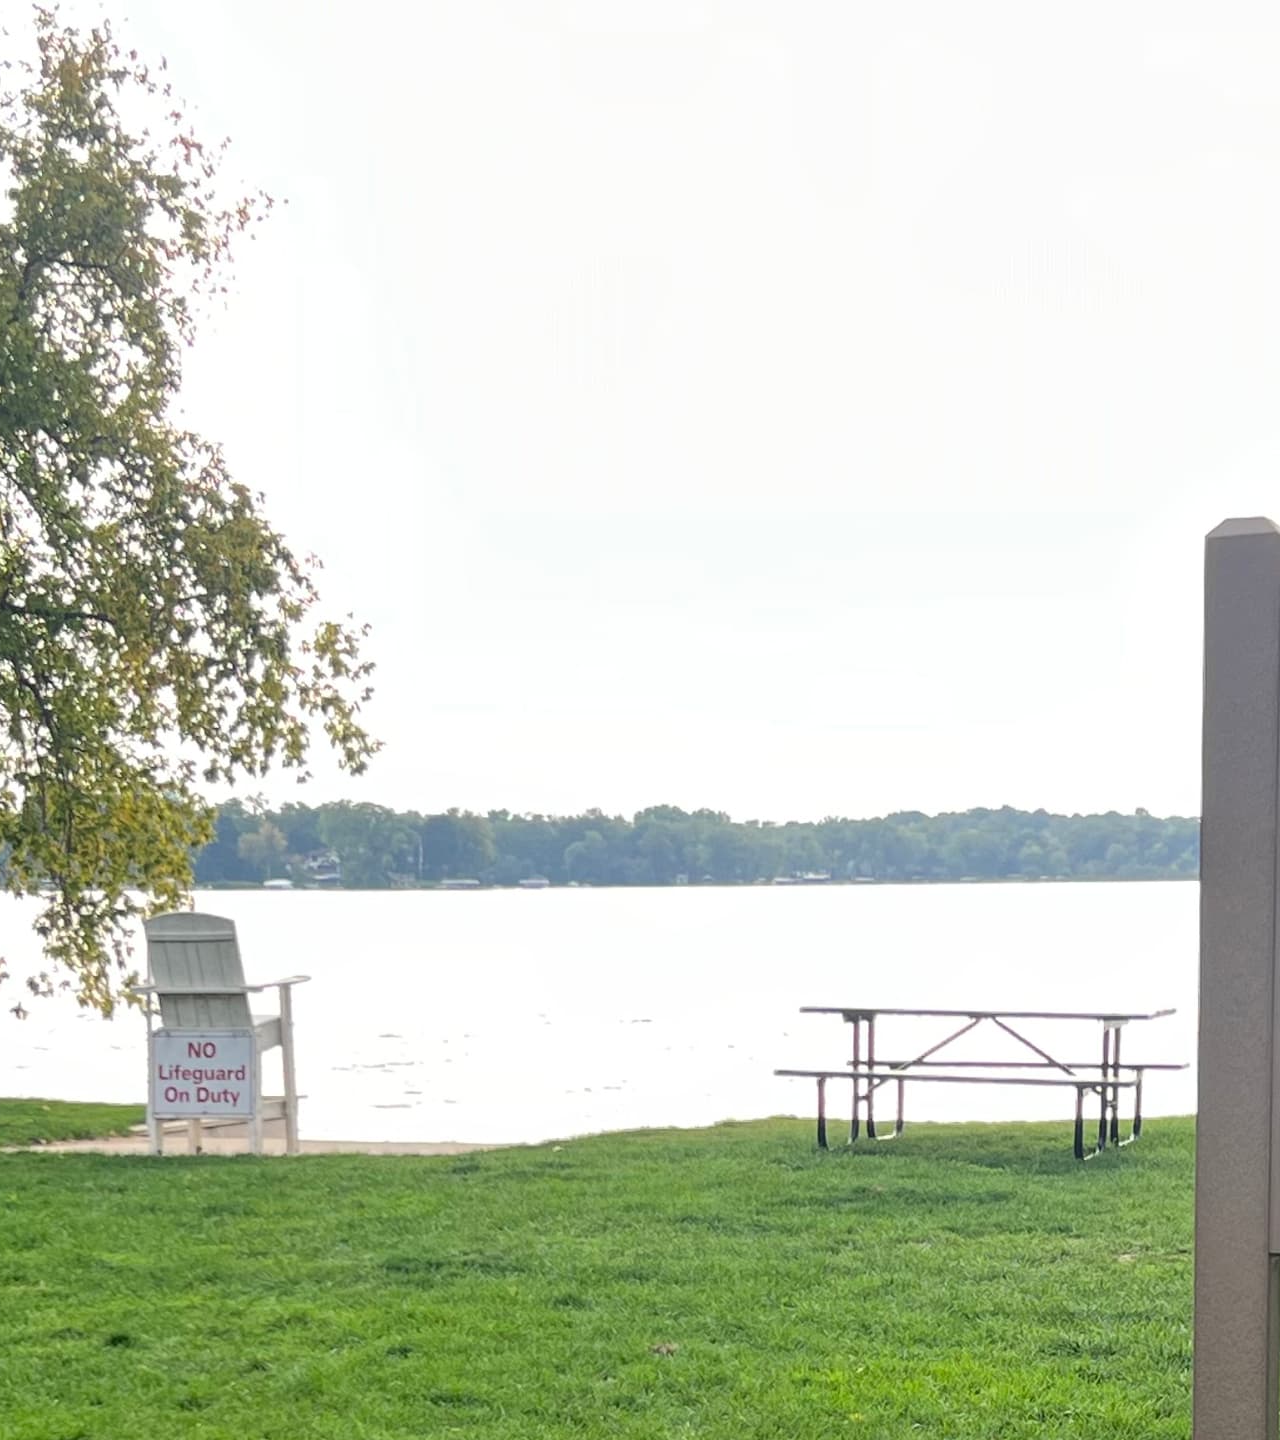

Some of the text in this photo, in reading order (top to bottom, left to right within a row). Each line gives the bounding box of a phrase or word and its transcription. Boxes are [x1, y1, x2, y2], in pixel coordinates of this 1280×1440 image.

[188, 1043, 216, 1058] NO
[159, 1065, 245, 1084] Lifeguard
[164, 1087, 240, 1106] On Duty
